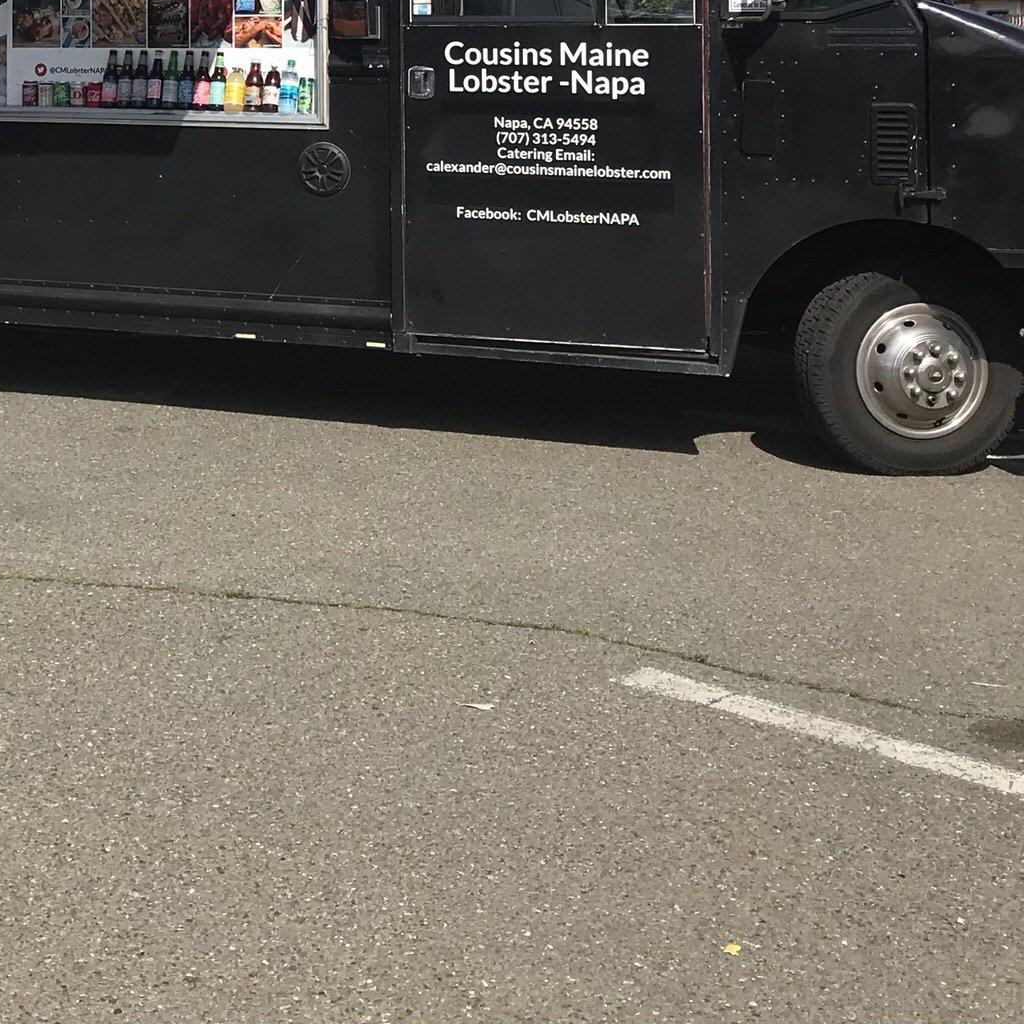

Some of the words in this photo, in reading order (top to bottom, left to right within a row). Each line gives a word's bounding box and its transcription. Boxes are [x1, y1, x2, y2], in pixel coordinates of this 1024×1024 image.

[444, 41, 553, 66] Cousins
[560, 42, 649, 67] Maine
[448, 68, 553, 94] Lobster
[559, 70, 646, 100] -Napa
[493, 117, 531, 130] Napa,
[533, 118, 553, 130] CA
[556, 118, 598, 130] 94558
[496, 132, 530, 146] (707)
[532, 133, 596, 146] 313-5494
[497, 147, 553, 163] Catering
[556, 149, 595, 161] Email:
[426, 161, 671, 180] calexander@cousinsmainelobster.com
[456, 206, 522, 221] Facebook:
[526, 209, 640, 226] CMLobsterNAPA
